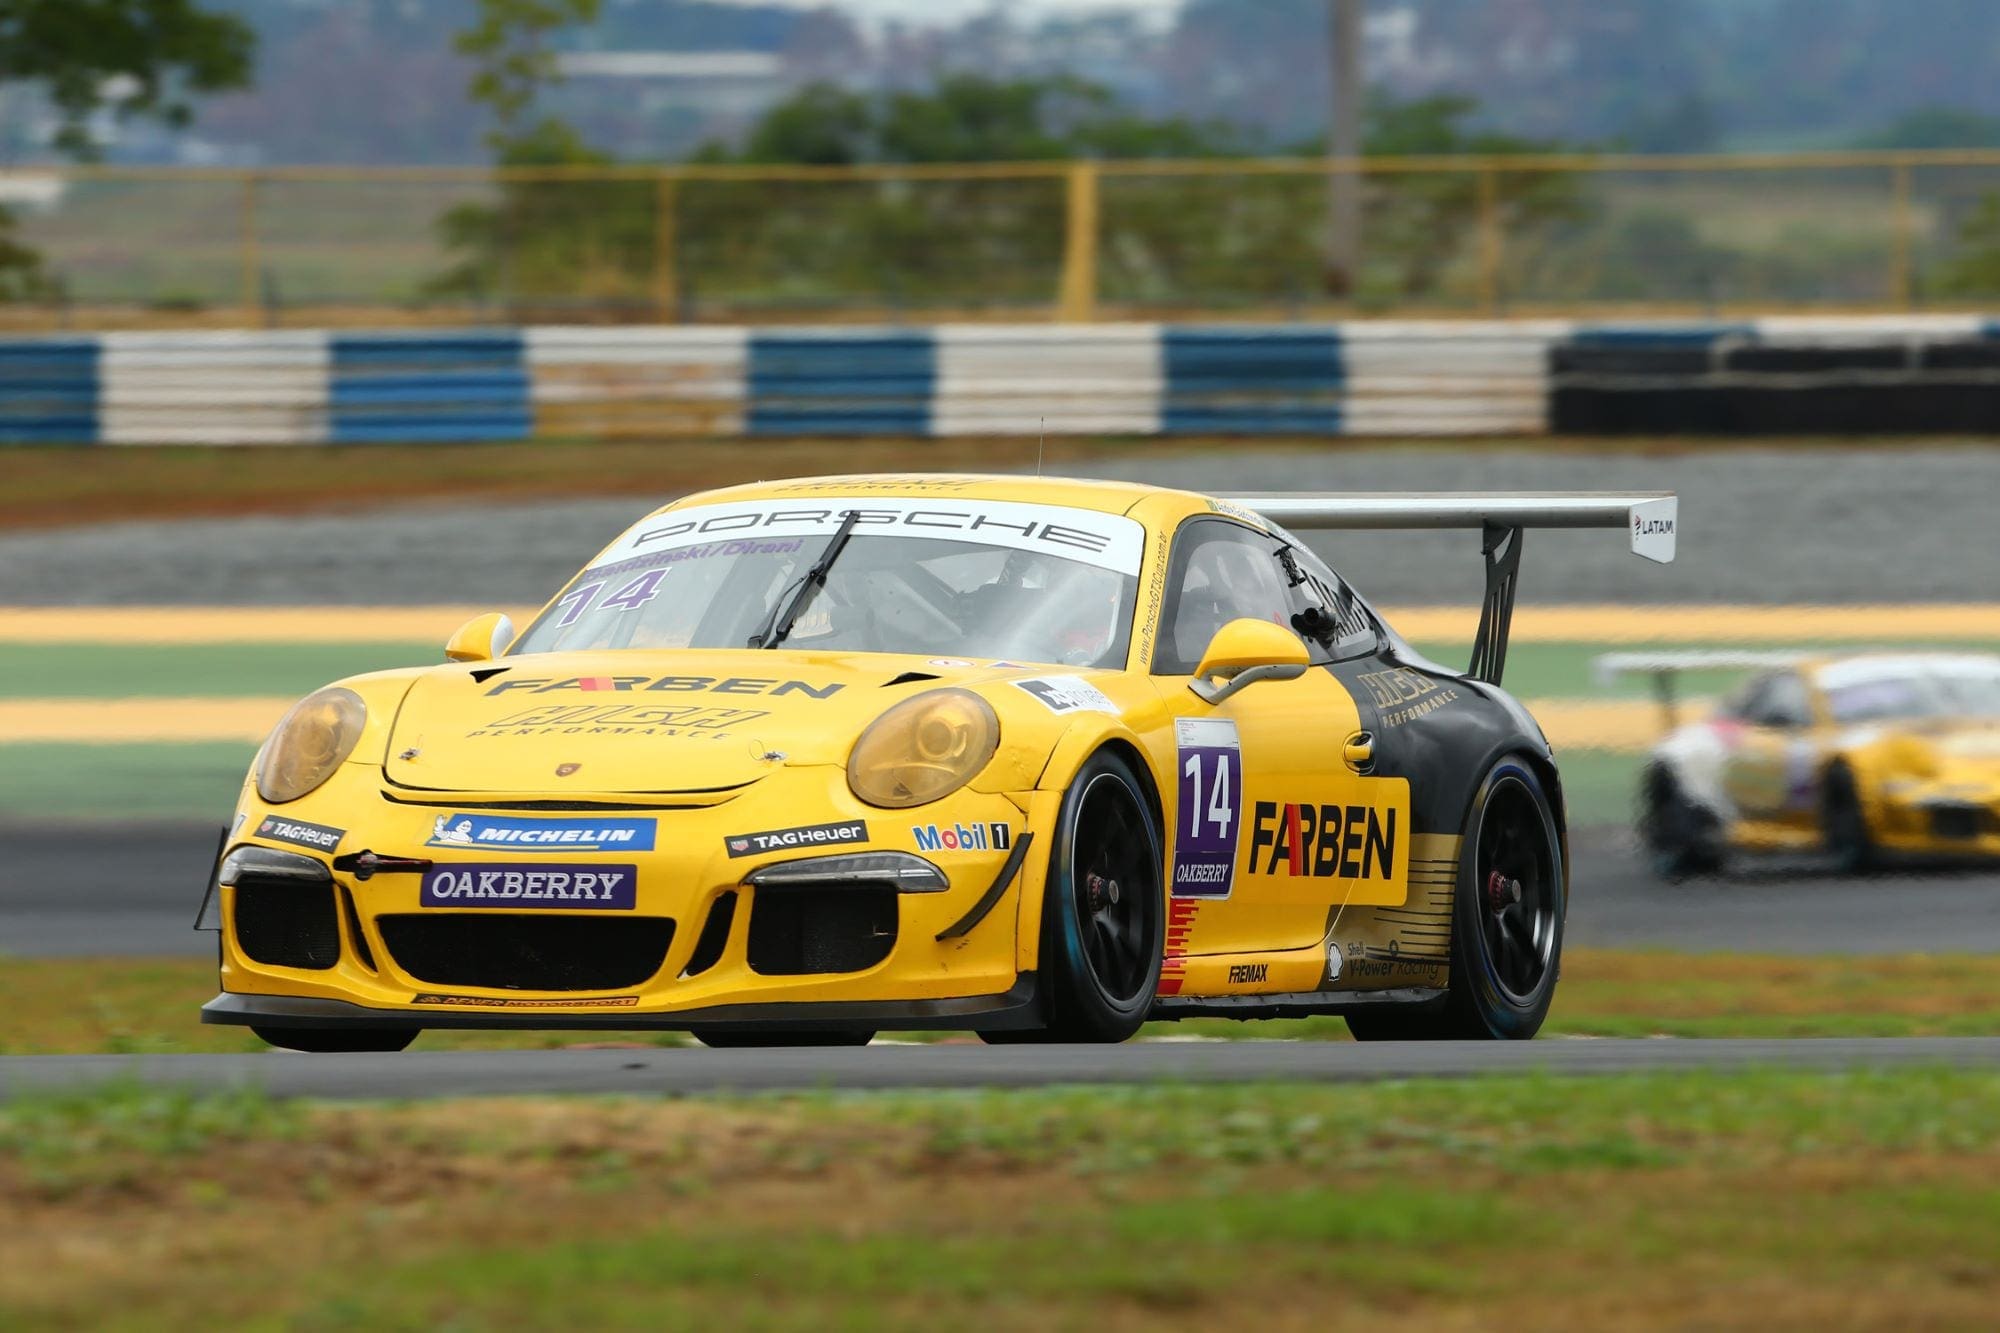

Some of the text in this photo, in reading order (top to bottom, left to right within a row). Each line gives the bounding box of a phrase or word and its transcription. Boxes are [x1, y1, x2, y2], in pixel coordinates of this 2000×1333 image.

[632, 508, 1112, 553] PORSCHE
[1642, 520, 1674, 535] LATAM
[555, 566, 673, 629] 14
[1140, 531, 1168, 665] www.PorscheGT3Cup.com.br
[484, 675, 847, 700] FARBEN
[487, 704, 772, 730] HIGH
[1382, 689, 1459, 728] PERFORMANCE
[465, 727, 733, 741] PERFORMANCE
[1185, 755, 1232, 838] 14
[477, 828, 636, 843] MICHELIN
[913, 823, 987, 851] Mobil
[1248, 800, 1396, 880] FARBEN
[1175, 863, 1229, 883] OAKBERRY
[431, 871, 624, 901] OAKBERRY
[1347, 942, 1365, 956] Shell
[1228, 964, 1268, 984] FREMAX
[1349, 960, 1394, 976] V-Power
[505, 998, 636, 1007] MOTORSPORT
